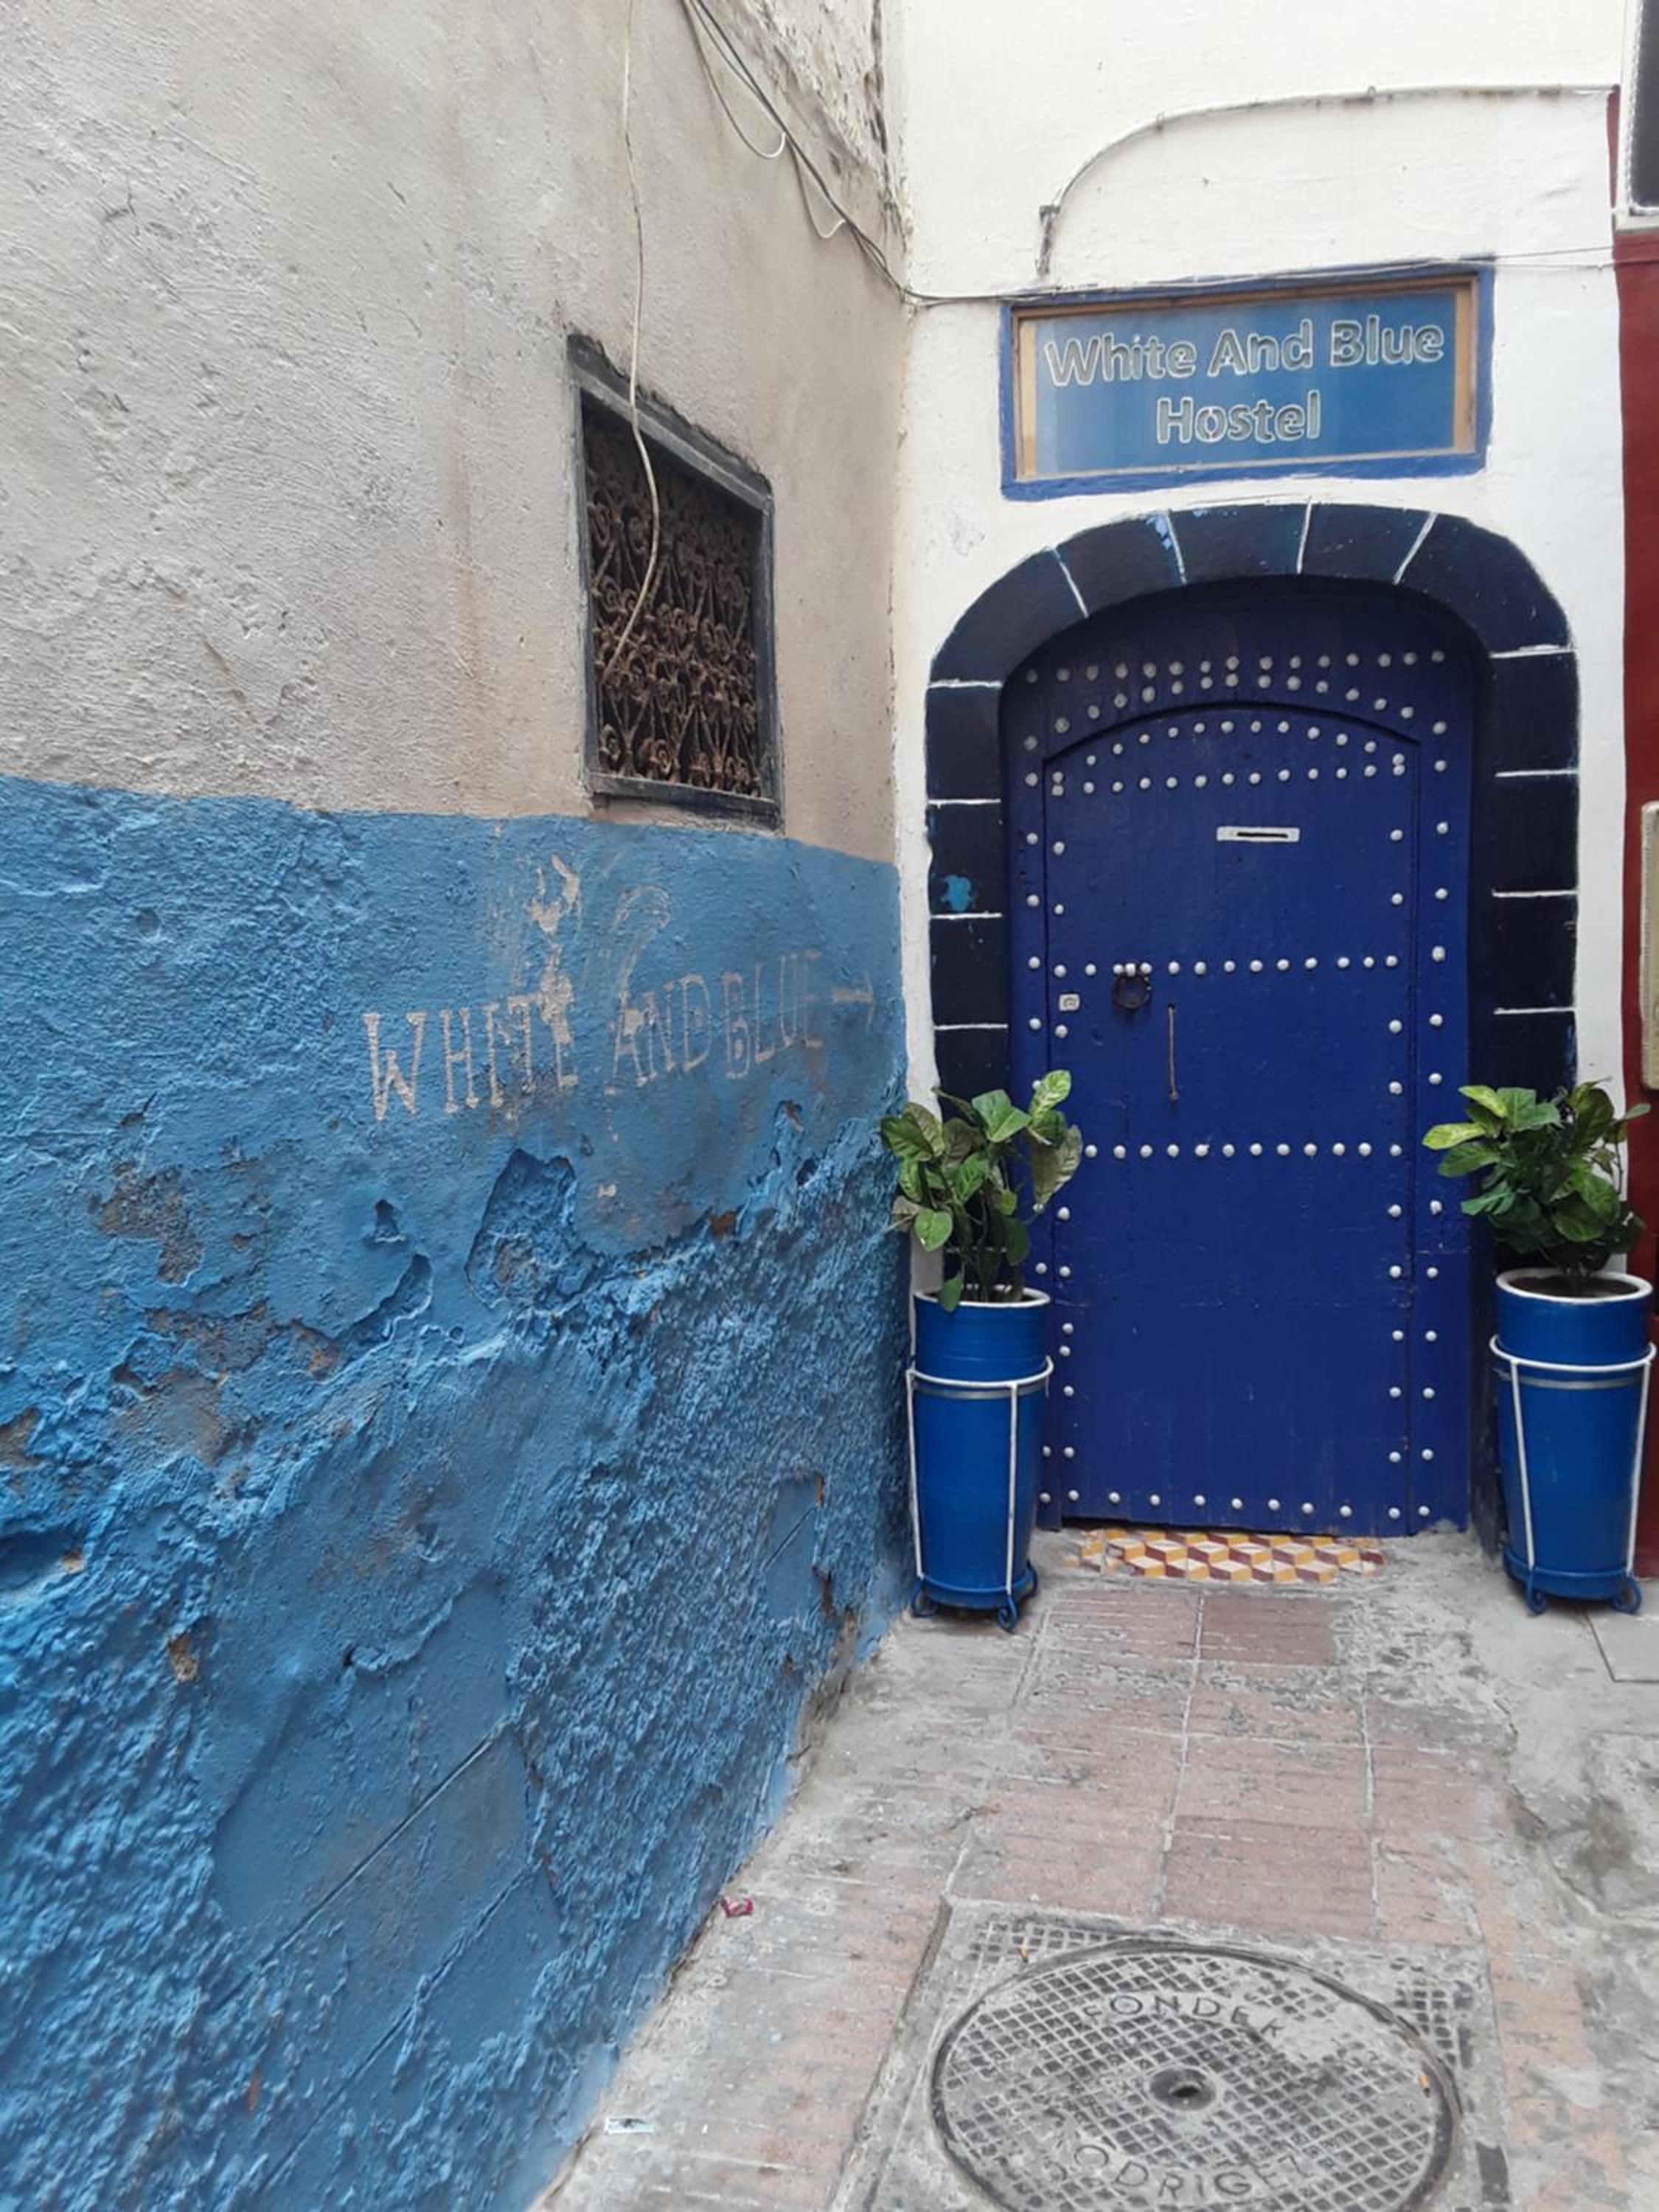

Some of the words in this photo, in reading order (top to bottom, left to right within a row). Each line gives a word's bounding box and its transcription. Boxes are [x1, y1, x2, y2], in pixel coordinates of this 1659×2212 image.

[1045, 332, 1197, 387] White
[1207, 318, 1314, 378] And
[1329, 315, 1445, 366] Blue
[1155, 389, 1321, 445] Hostel
[362, 987, 580, 1121] WHITE
